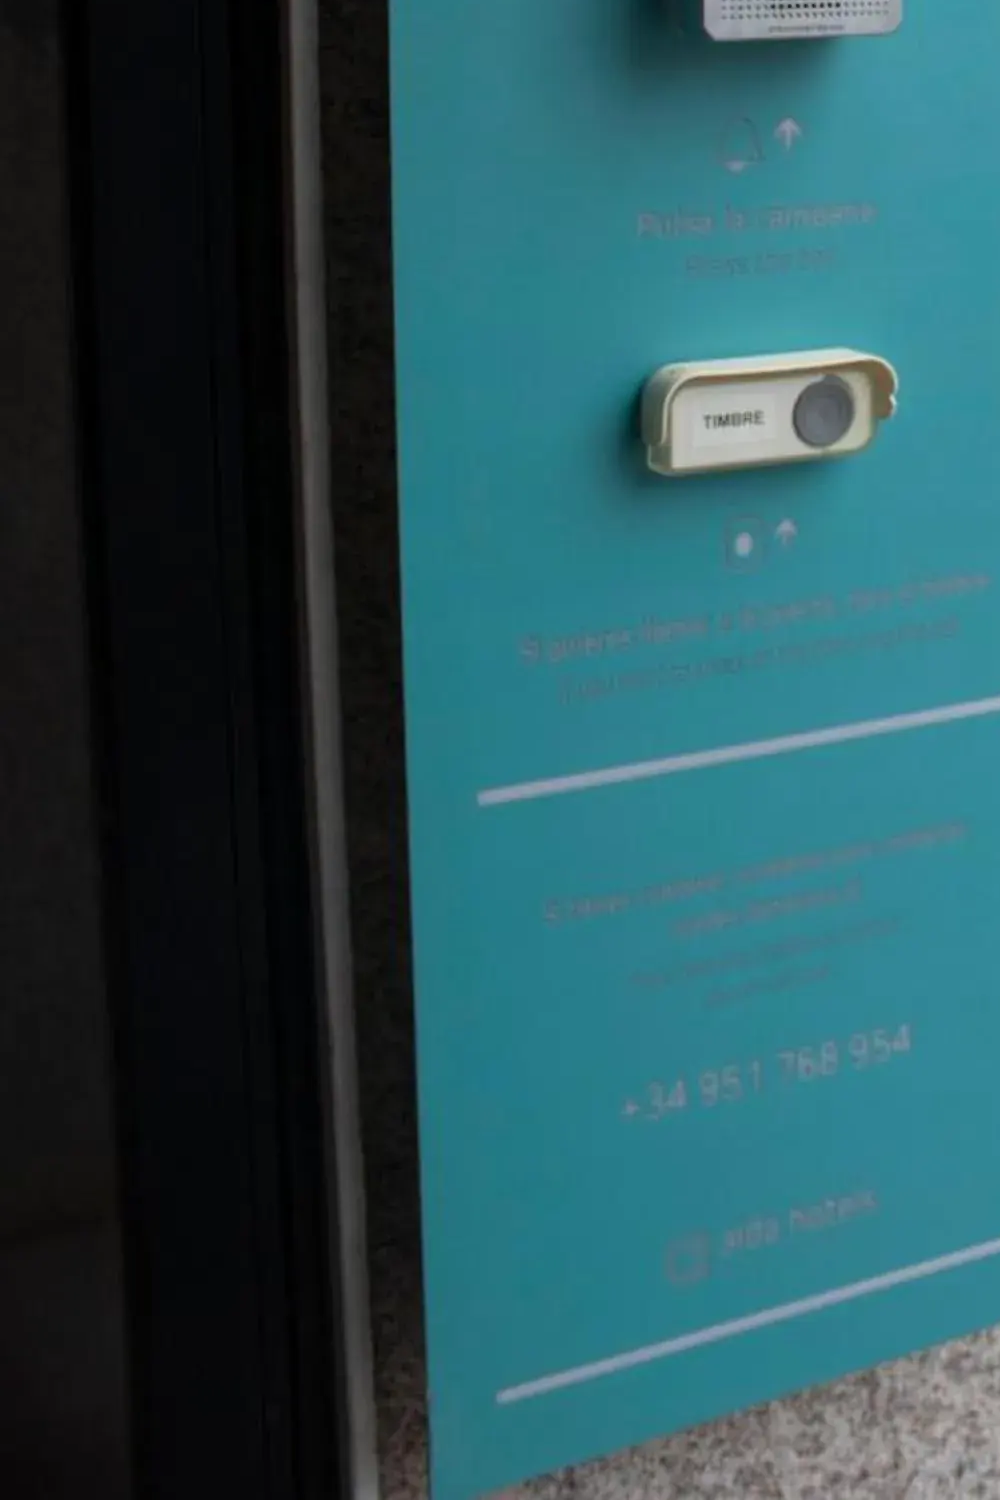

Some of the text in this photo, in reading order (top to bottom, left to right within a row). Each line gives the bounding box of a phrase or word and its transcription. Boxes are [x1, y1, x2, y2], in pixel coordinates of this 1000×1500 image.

[703, 410, 765, 430] TIMBRE
[698, 1059, 764, 1108] 951
[777, 1040, 839, 1085] 768
[848, 1023, 913, 1071] 954
